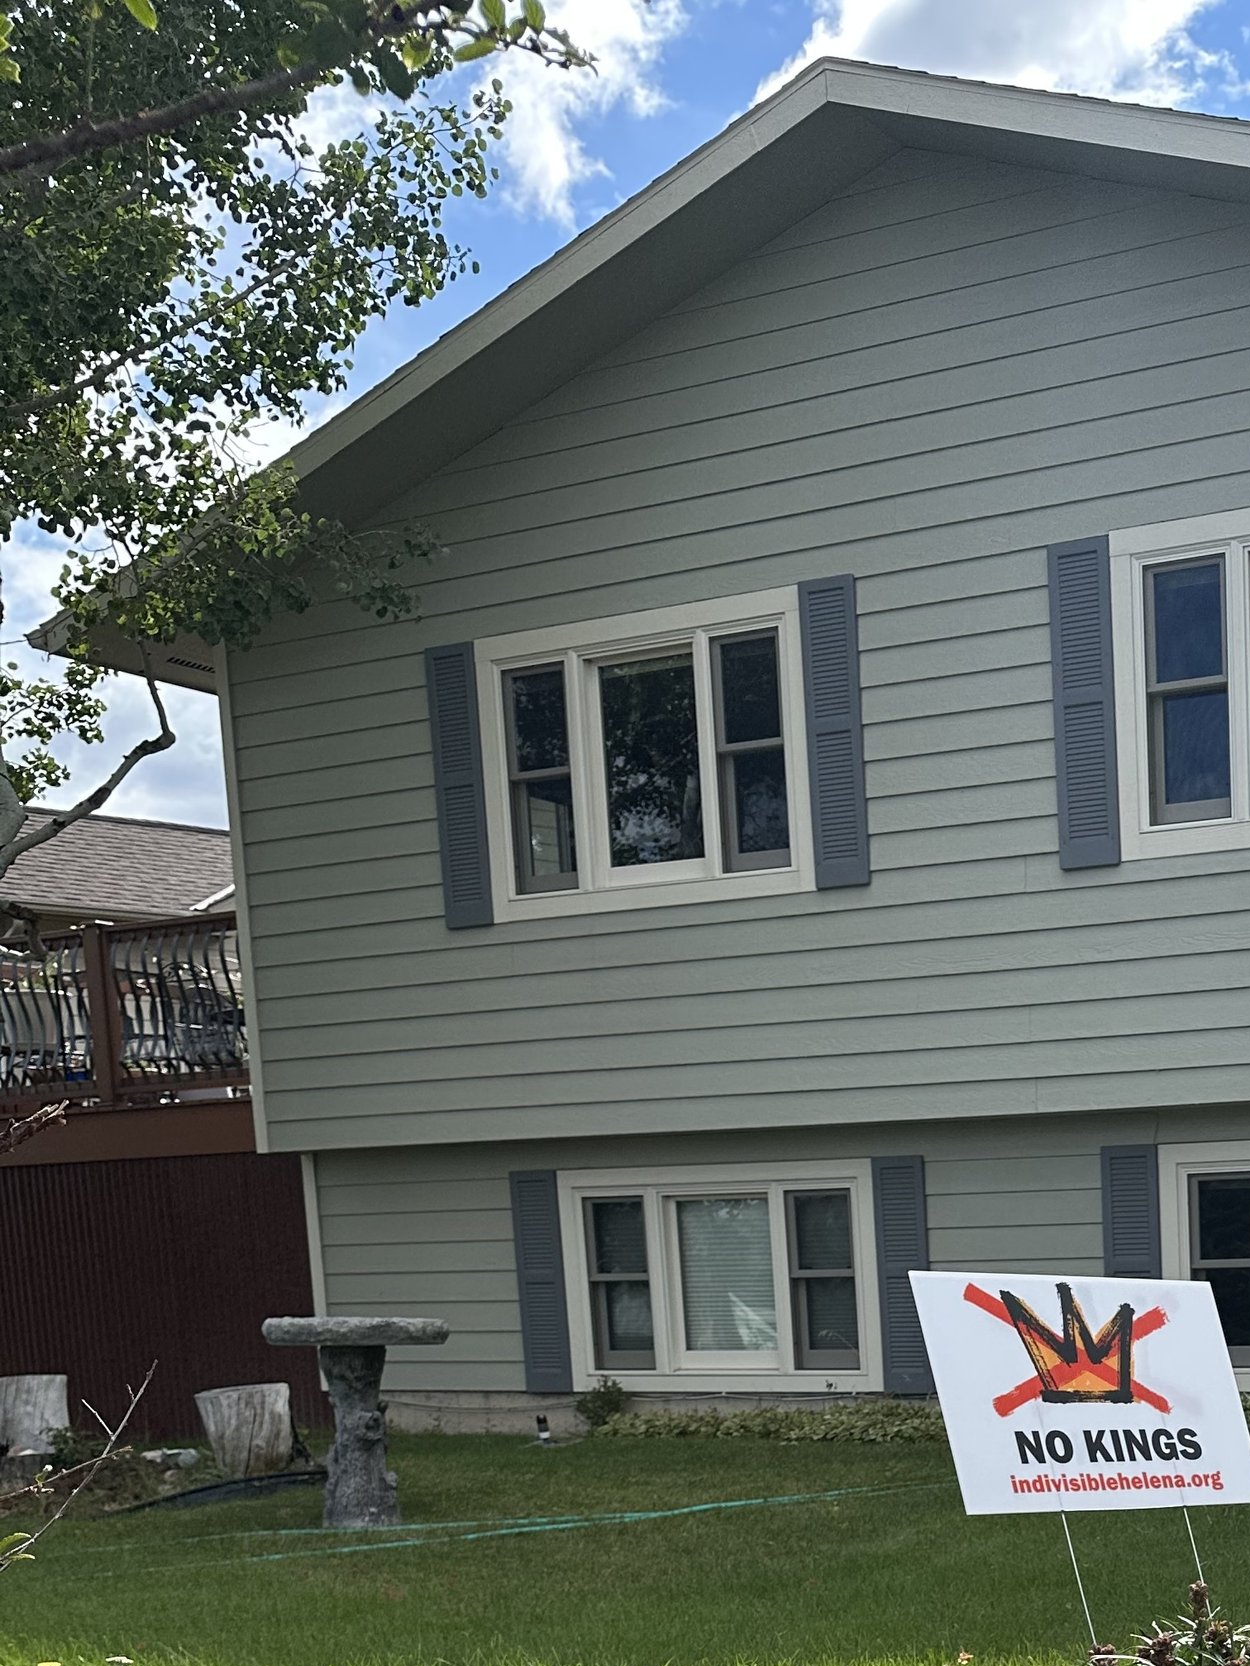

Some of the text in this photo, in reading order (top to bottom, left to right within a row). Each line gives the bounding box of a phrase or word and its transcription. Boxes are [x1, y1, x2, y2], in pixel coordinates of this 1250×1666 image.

[1014, 1428, 1202, 1465] NO KINGS
[1010, 1471, 1224, 1494] indivisiblehelena.org
